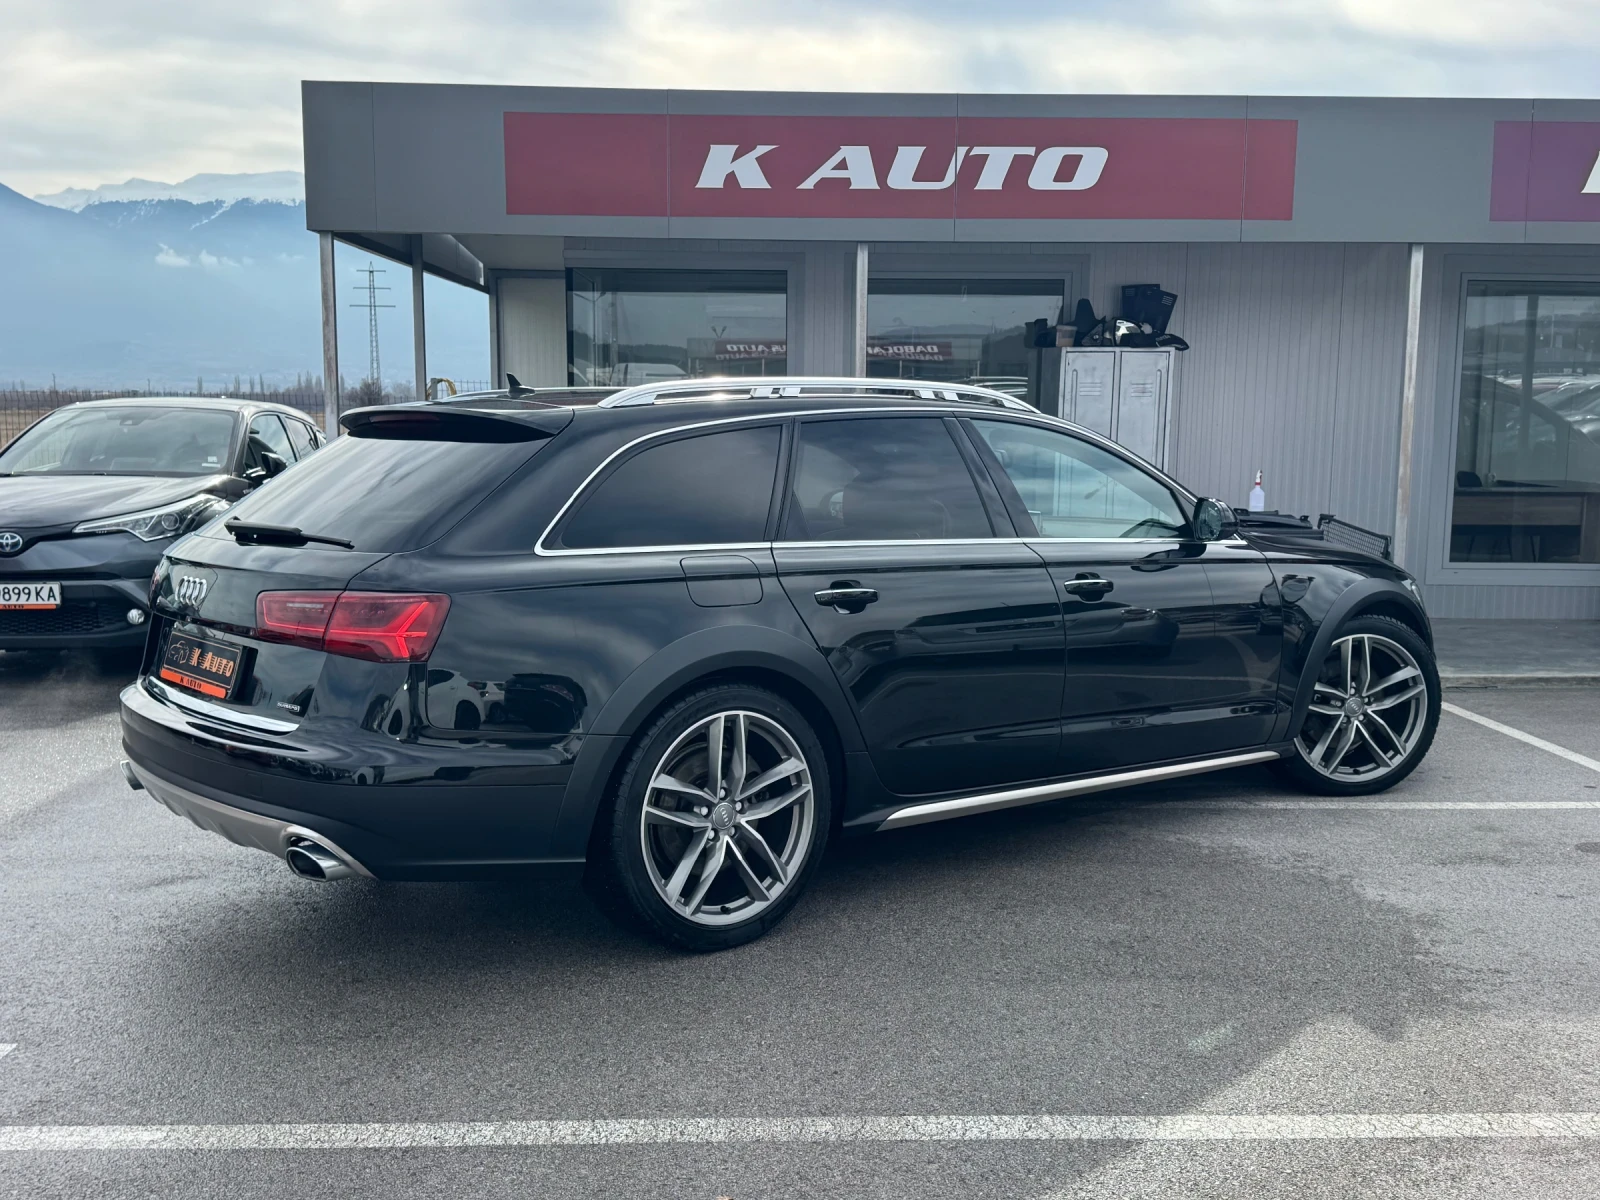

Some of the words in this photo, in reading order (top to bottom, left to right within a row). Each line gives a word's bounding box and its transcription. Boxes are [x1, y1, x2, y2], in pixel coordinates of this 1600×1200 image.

[695, 144, 780, 189] K
[796, 145, 1109, 191] AUTO
[0, 586, 31, 602] 899
[35, 586, 57, 602] KA
